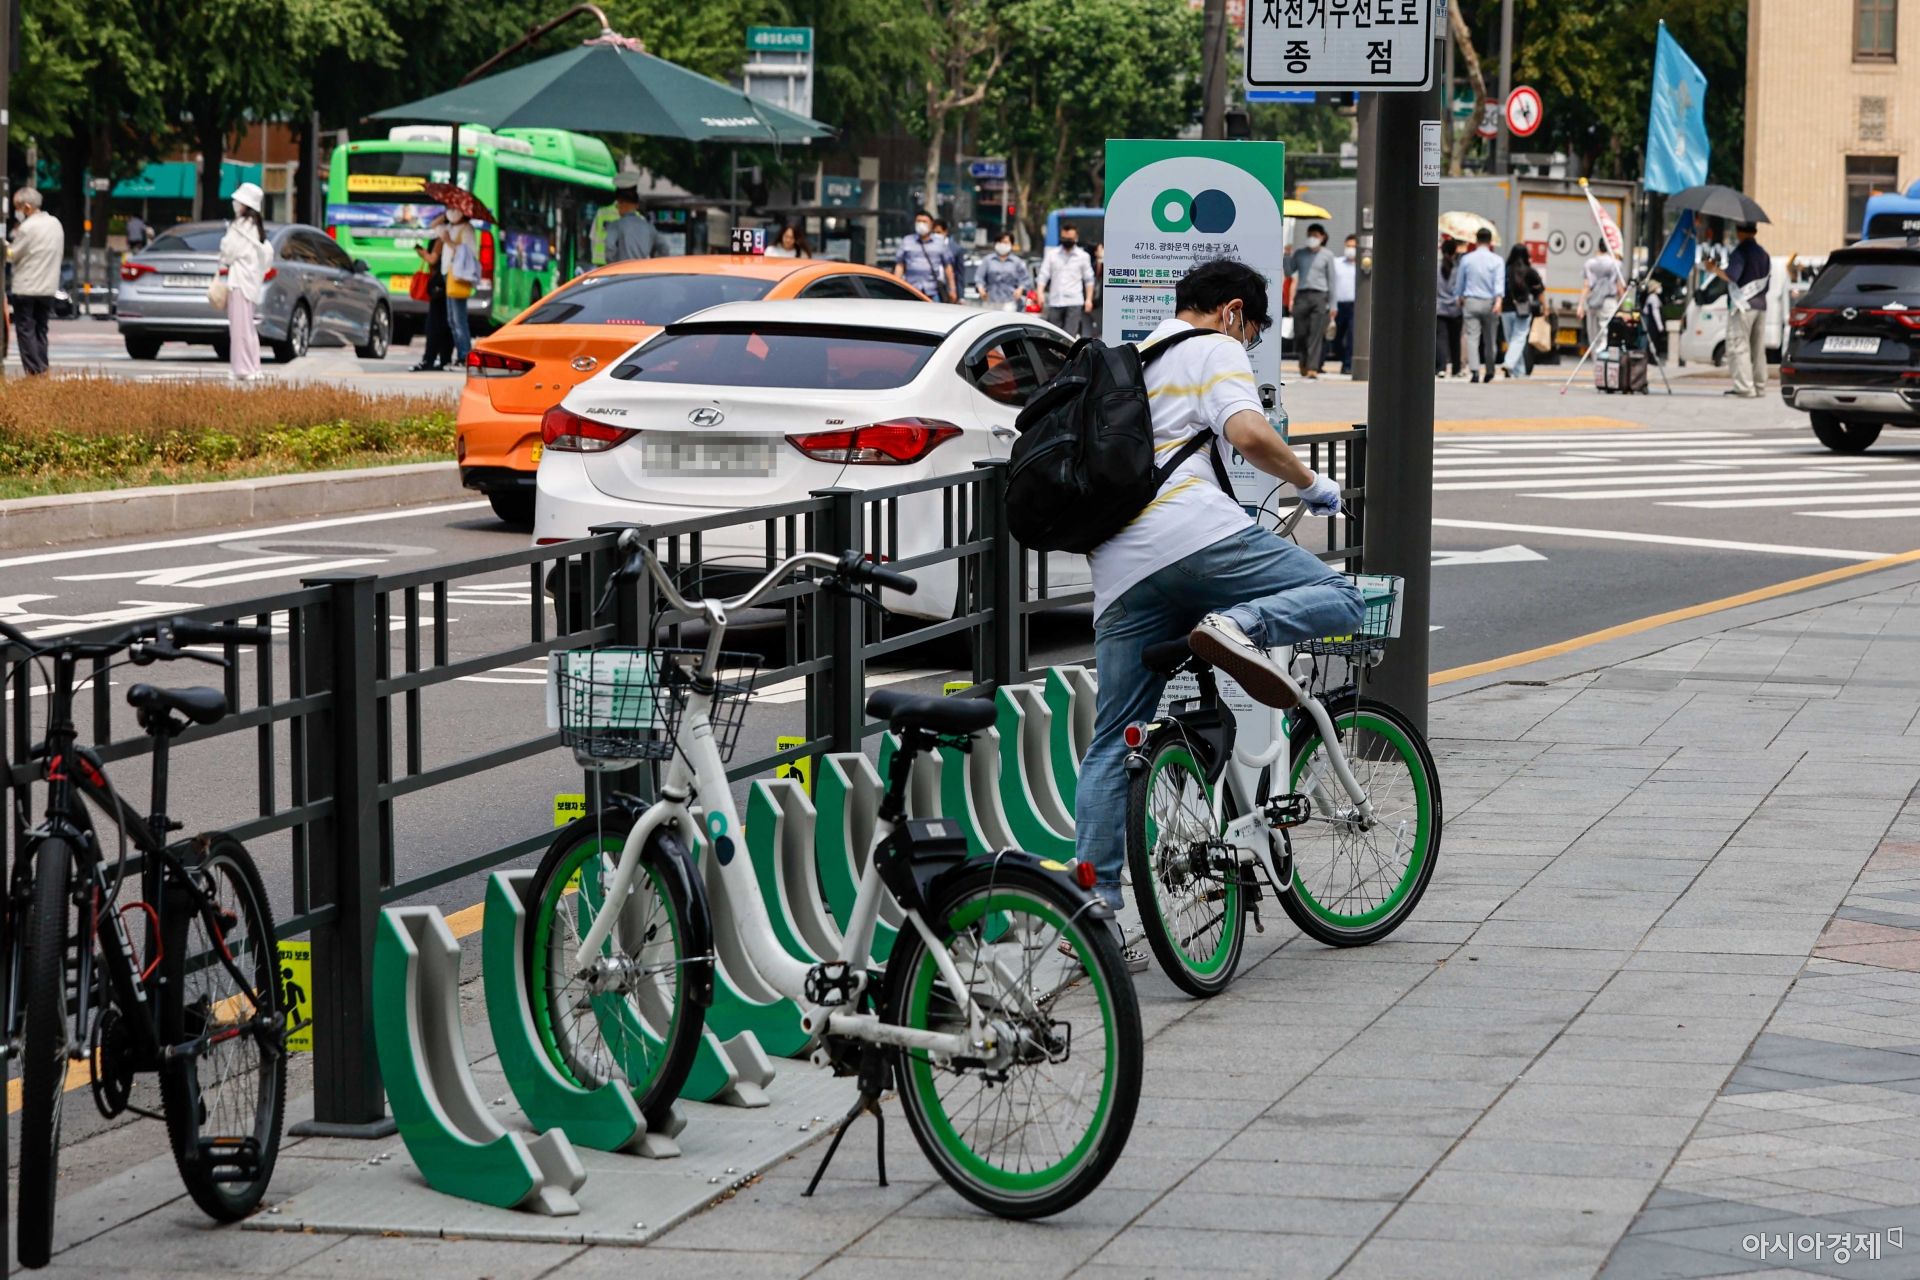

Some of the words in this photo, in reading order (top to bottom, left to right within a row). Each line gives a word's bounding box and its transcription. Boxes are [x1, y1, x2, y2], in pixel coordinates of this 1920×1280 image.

[1262, 0, 1419, 29] 자전거우선도로
[1283, 40, 1311, 74] 종
[1366, 39, 1392, 75] 점
[1134, 242, 1157, 251] 4718.
[1159, 242, 1190, 252] 광화문역
[1191, 242, 1221, 253] 6번출구
[1222, 243, 1231, 253] 옆
[1232, 244, 1239, 252] A
[1108, 268, 1137, 277] 제로페이
[1139, 269, 1153, 278] 할인
[1155, 269, 1170, 278] 종료
[1121, 294, 1155, 303] 서울자전거
[585, 407, 628, 416] AVANTE
[557, 801, 579, 811] 보행자
